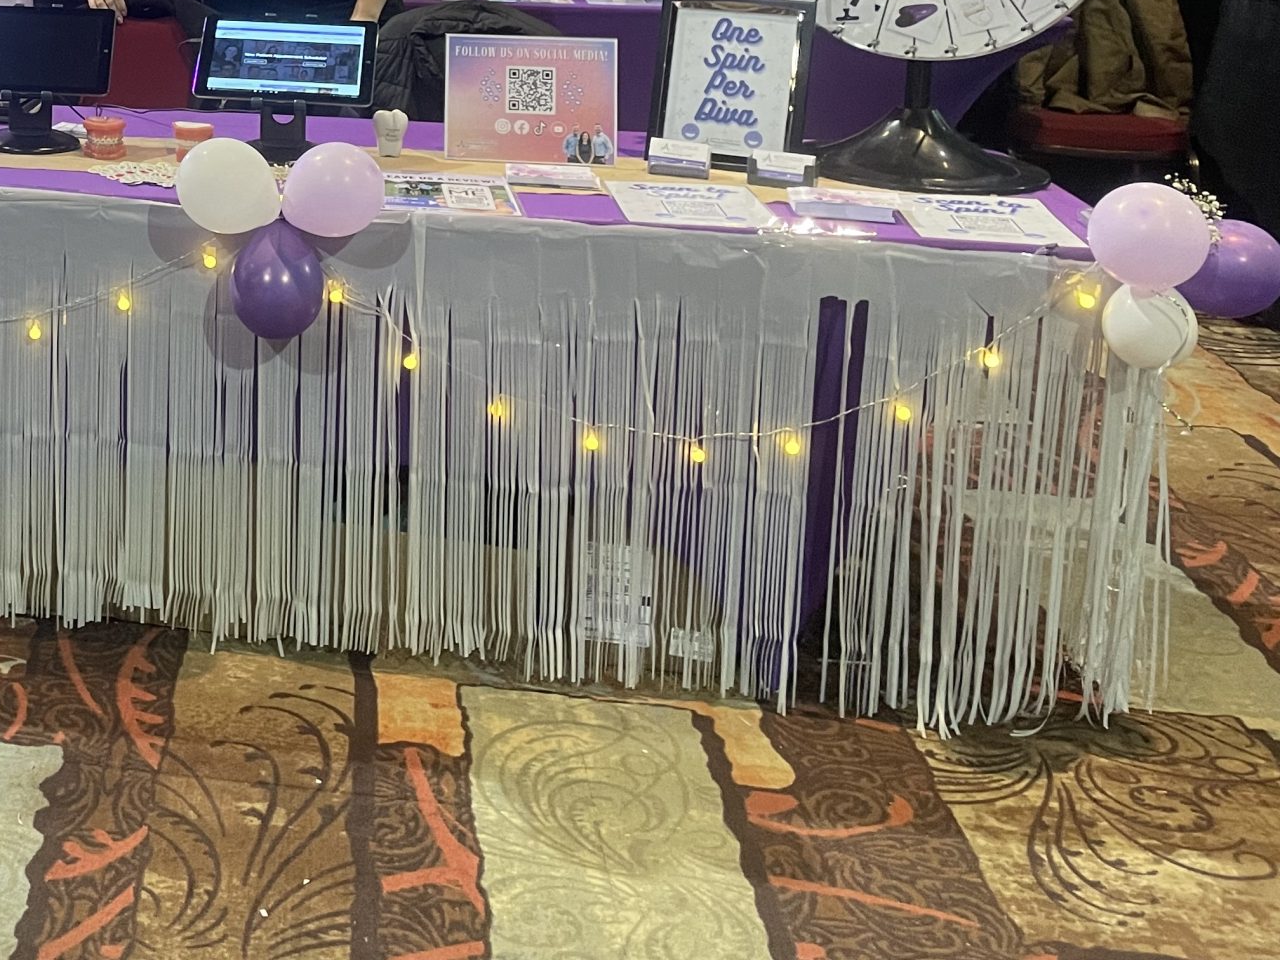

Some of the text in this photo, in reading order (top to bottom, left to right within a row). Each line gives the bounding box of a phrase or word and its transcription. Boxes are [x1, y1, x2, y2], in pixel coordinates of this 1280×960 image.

[711, 17, 763, 44] One
[455, 45, 609, 62] FOLLOW US ON SOCIAL MEDIA!
[703, 44, 766, 72] Spin
[704, 70, 755, 98] Per
[694, 97, 758, 126] Diva
[628, 183, 739, 194] Scan to
[646, 190, 731, 200] Spin!
[914, 197, 1032, 209] Scan to
[935, 204, 1022, 215] Spin!
